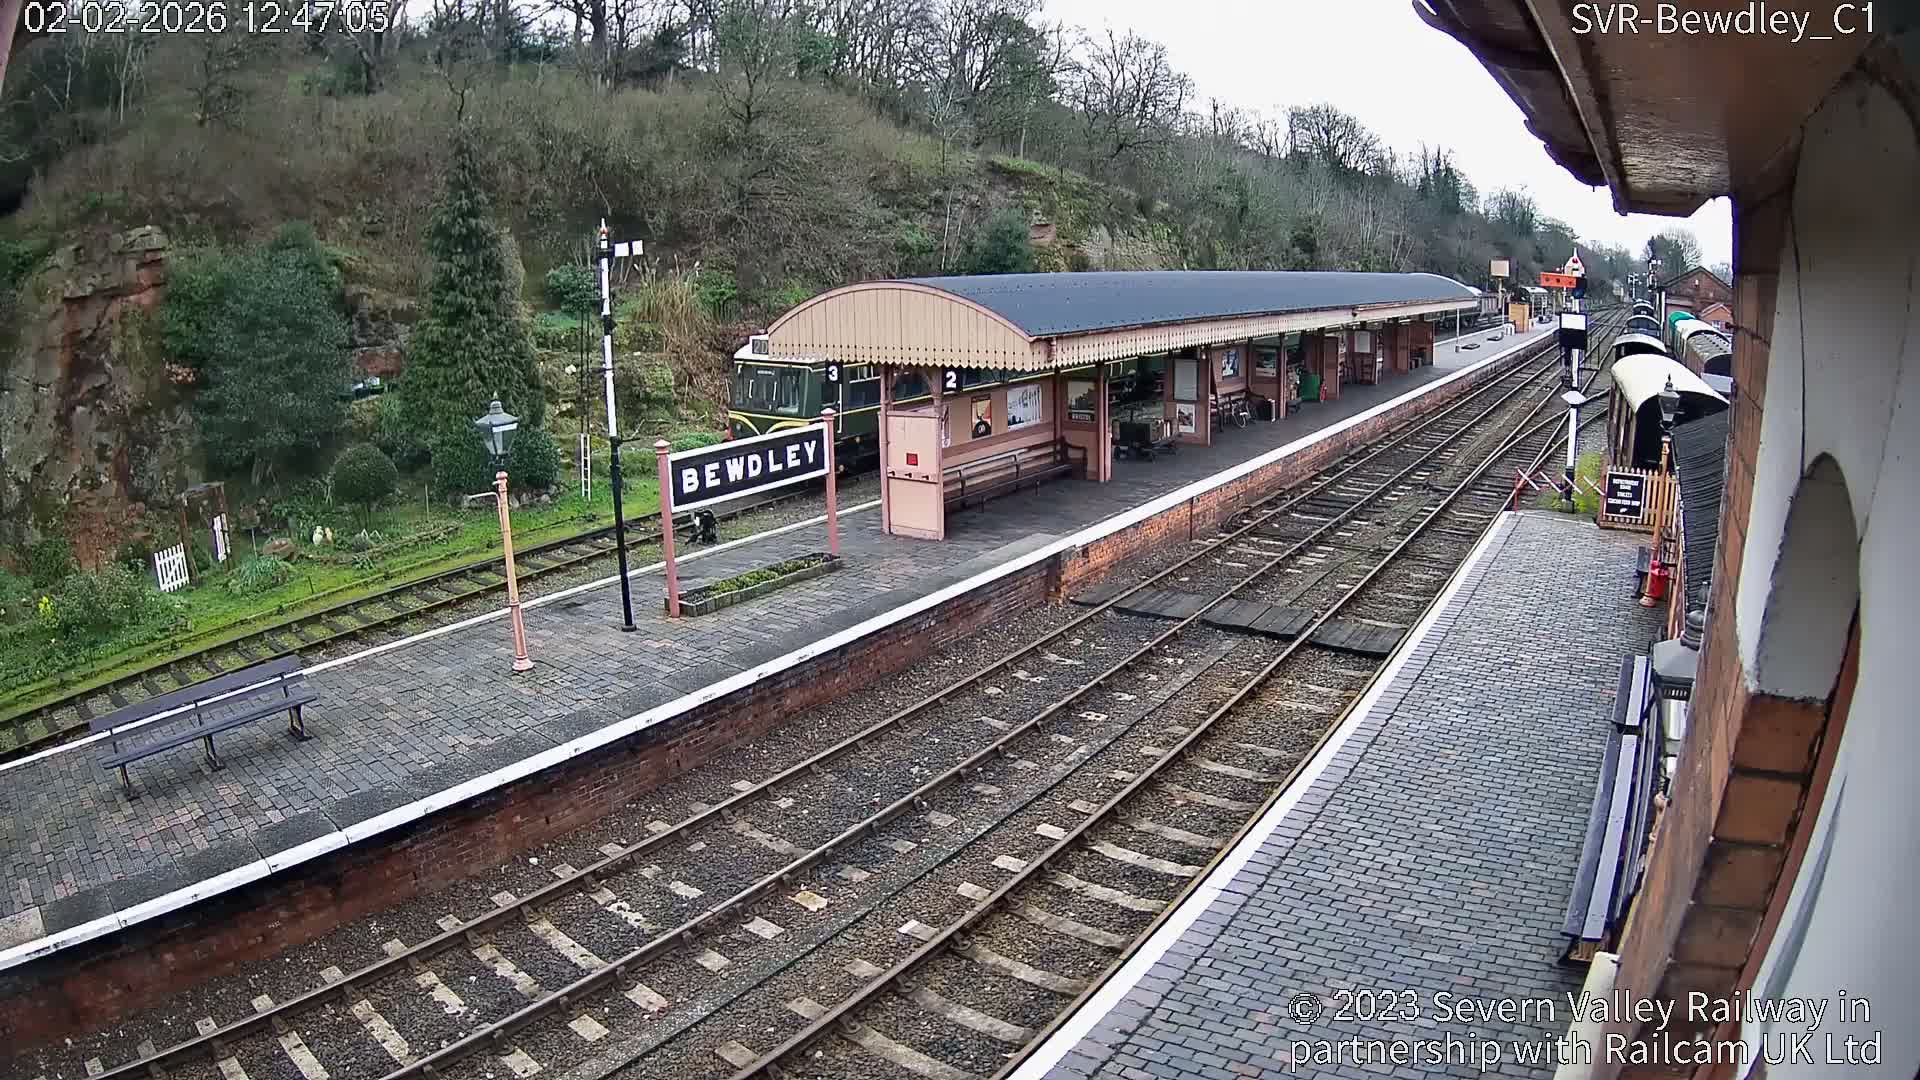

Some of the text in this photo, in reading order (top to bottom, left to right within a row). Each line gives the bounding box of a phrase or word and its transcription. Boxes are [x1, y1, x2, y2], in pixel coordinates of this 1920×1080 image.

[828, 365, 839, 381] 3
[945, 371, 957, 388] 2
[681, 440, 817, 494] BEWDLEY
